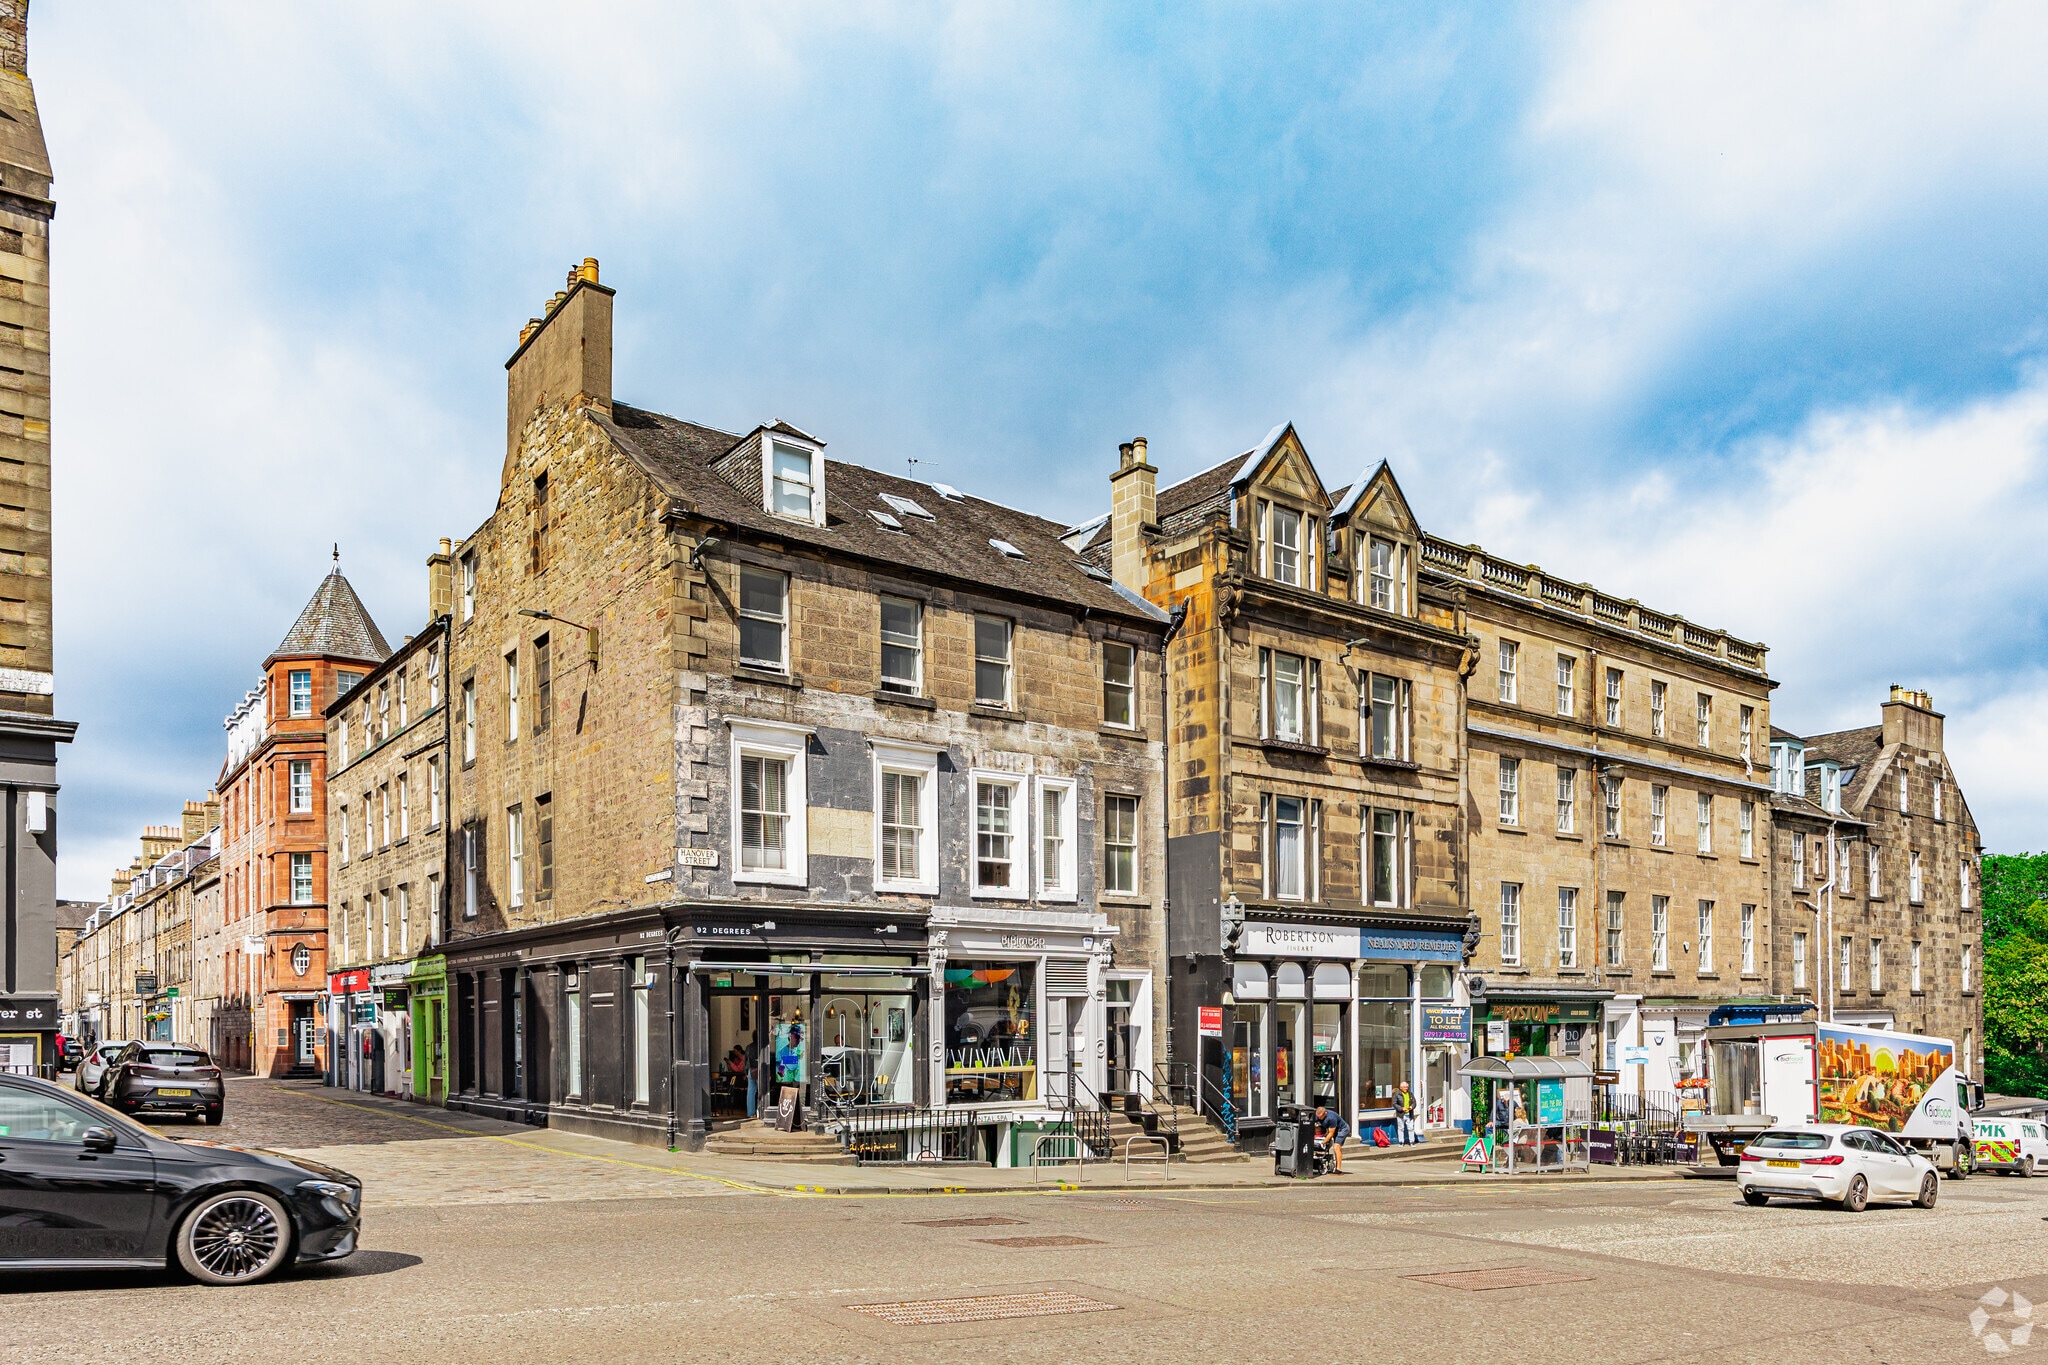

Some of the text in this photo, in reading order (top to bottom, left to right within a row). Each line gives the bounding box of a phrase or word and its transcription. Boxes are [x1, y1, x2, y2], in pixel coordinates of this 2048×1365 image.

[680, 849, 715, 858] HANOVER
[685, 857, 711, 865] STREET
[712, 927, 751, 935] DEGREES
[1266, 926, 1334, 944] ROBERTSON
[1367, 938, 1457, 952] NEAL'S YARD REMEDIES
[0, 1008, 43, 1019] er st
[1503, 1004, 1549, 1023] BOSTON
[1429, 1016, 1463, 1025] TO LET
[1928, 1104, 1952, 1119] Bidfood
[2022, 1125, 2039, 1138] PMK
